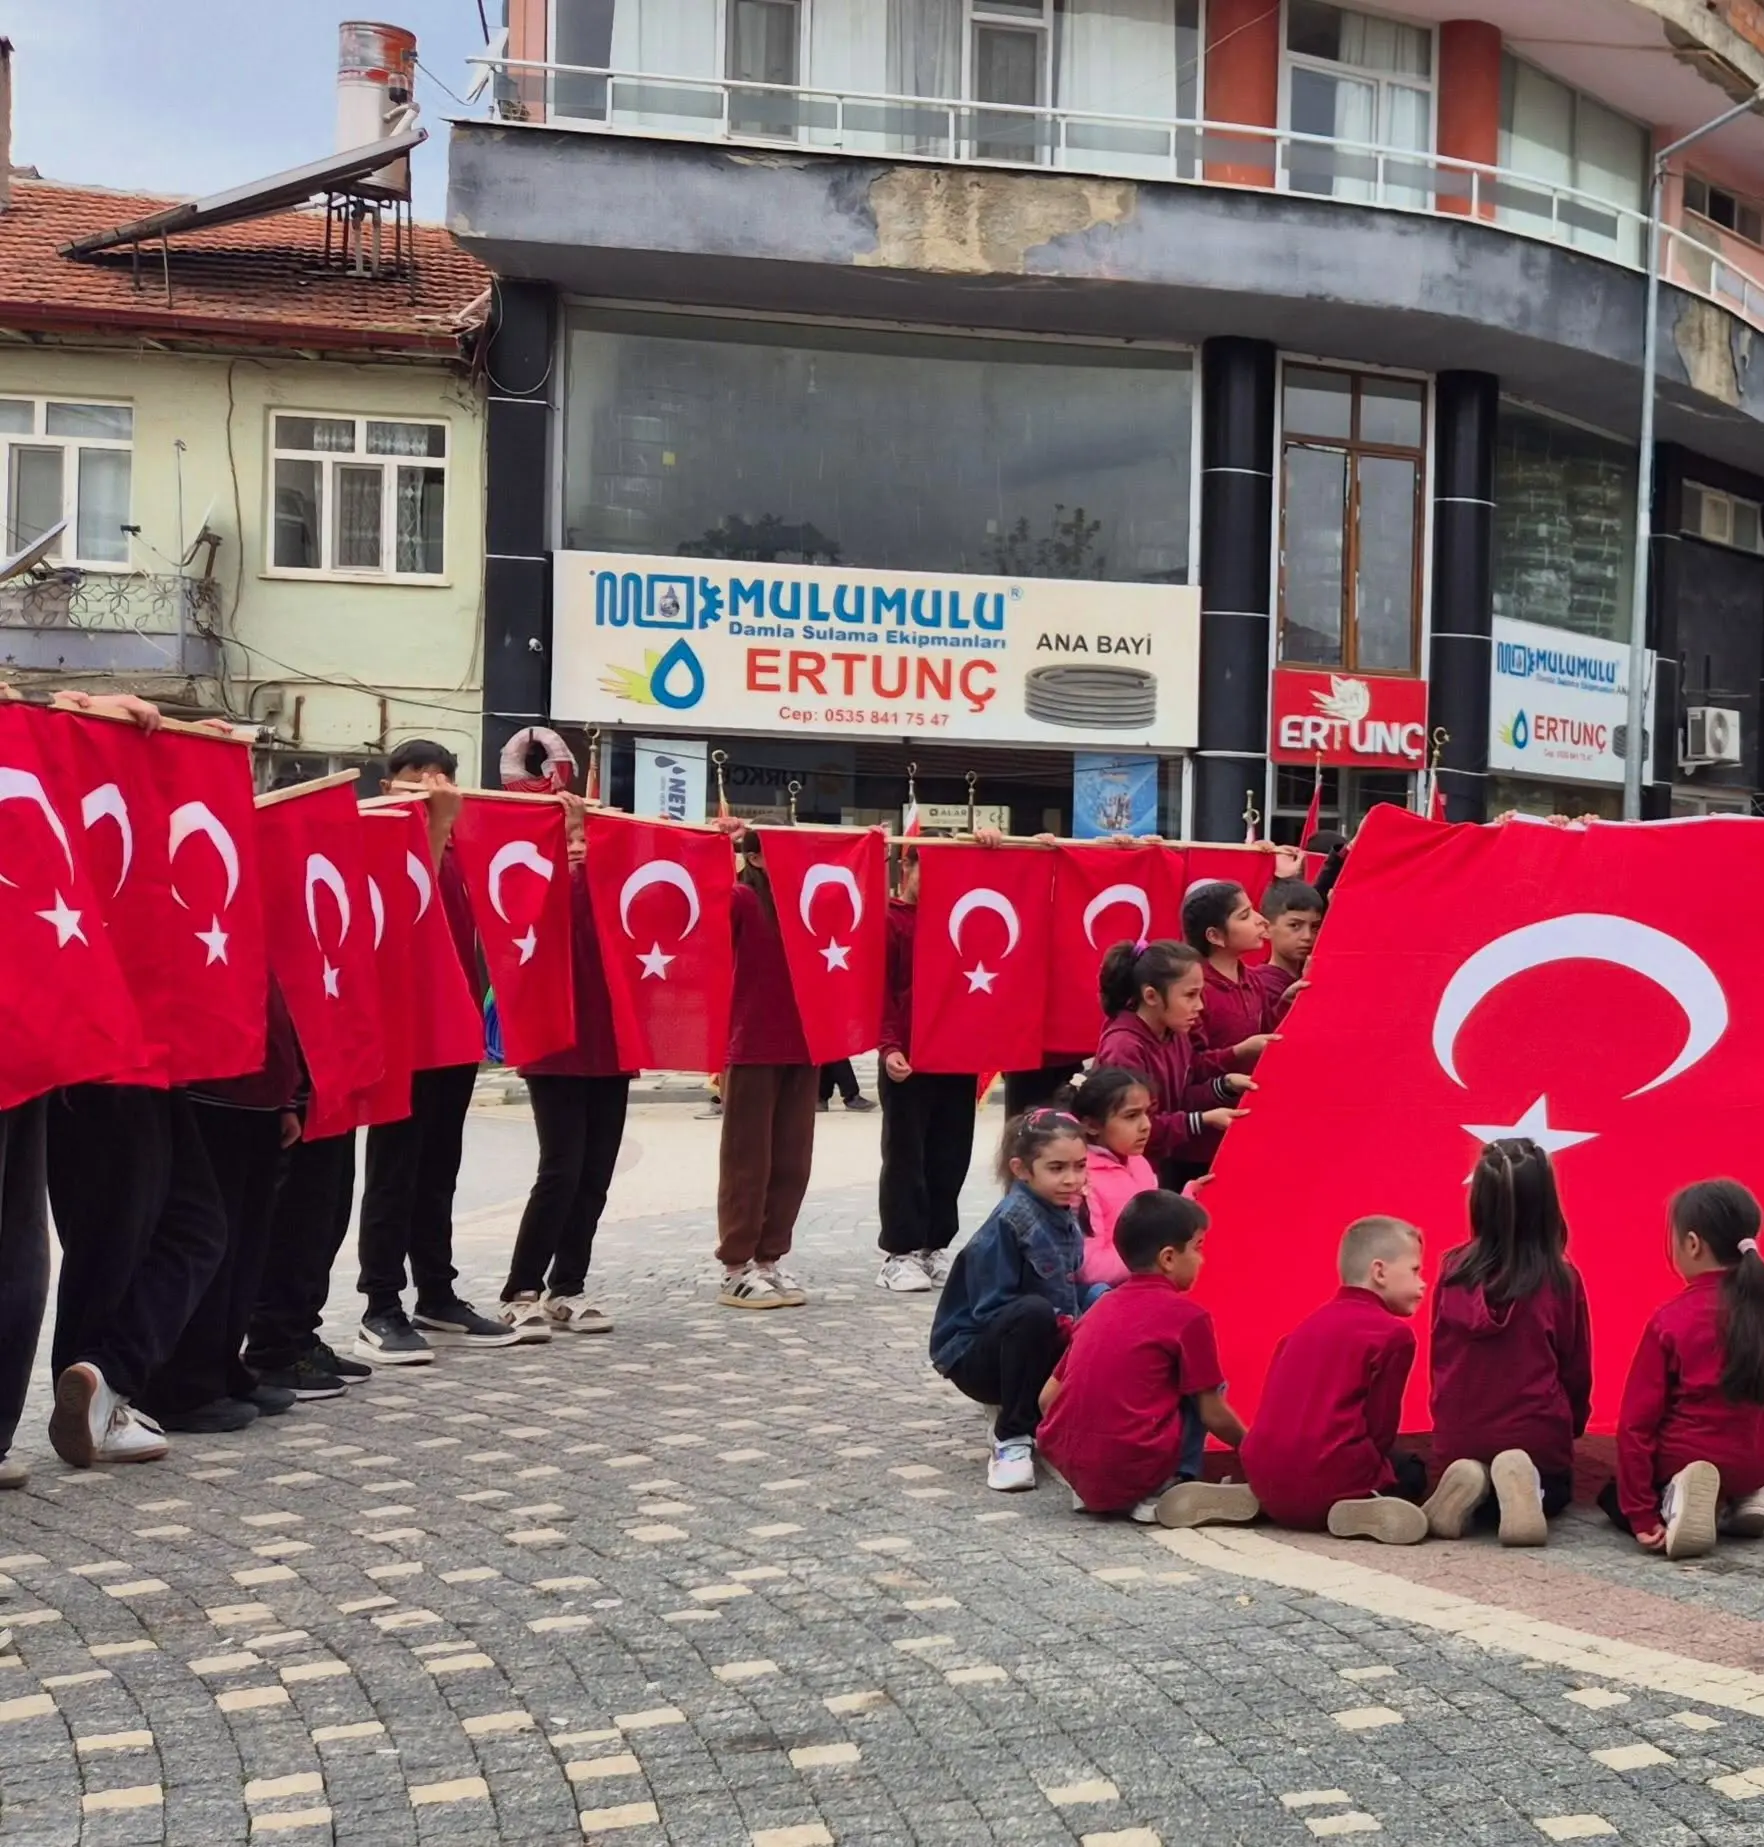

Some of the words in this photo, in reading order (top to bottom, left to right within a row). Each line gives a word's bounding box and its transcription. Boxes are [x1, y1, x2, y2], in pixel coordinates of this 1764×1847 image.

[728, 577, 1005, 630] MULUMULU
[729, 621, 795, 638] Damla
[803, 626, 878, 643] Sulama
[886, 630, 1006, 649] Ekipmanları
[1036, 633, 1088, 653] ANA
[1096, 633, 1152, 655] BAYİ
[746, 647, 998, 713] ERTUNÇ
[1536, 648, 1616, 684] MULUMULU
[778, 706, 818, 723] Cep:
[824, 708, 865, 723] 0535
[870, 710, 898, 725] 841
[906, 712, 925, 726] 75
[930, 714, 950, 727] 47
[1533, 714, 1607, 754] ERTUNÇ
[1279, 715, 1425, 761] ERTUNÇ
